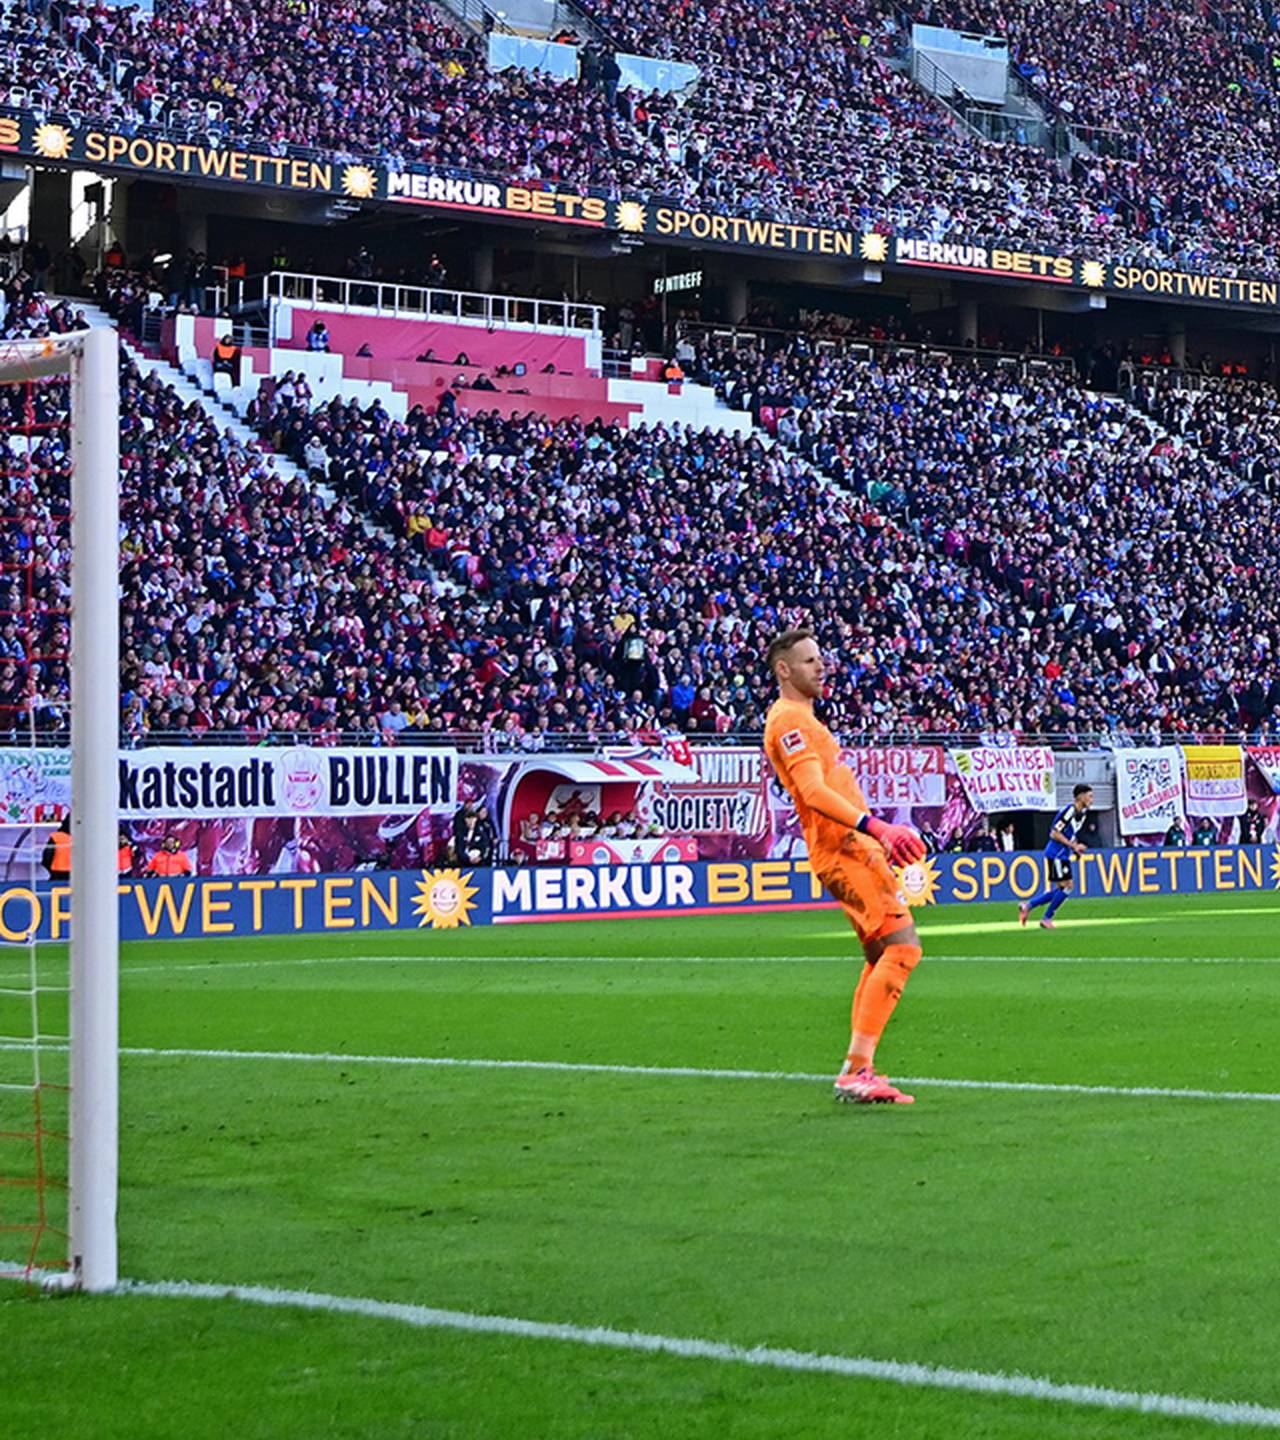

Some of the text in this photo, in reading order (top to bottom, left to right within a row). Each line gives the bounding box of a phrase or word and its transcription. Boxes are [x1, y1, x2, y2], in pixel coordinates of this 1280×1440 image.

[85, 133, 331, 190] SPORTWETTEN
[387, 173, 606, 220] MERKUR BETS
[655, 208, 852, 255] SPORTWETTEN
[897, 238, 1073, 277] MERKUR BETS
[1113, 266, 1276, 305] SPORTWETTEN
[118, 758, 275, 810] katstadt
[328, 756, 451, 806] BULLEN
[701, 753, 761, 783] WHITE
[653, 797, 738, 832] SOCIETY
[493, 861, 822, 912] MERKUR BET
[952, 849, 1262, 901] SPOTWETTEN
